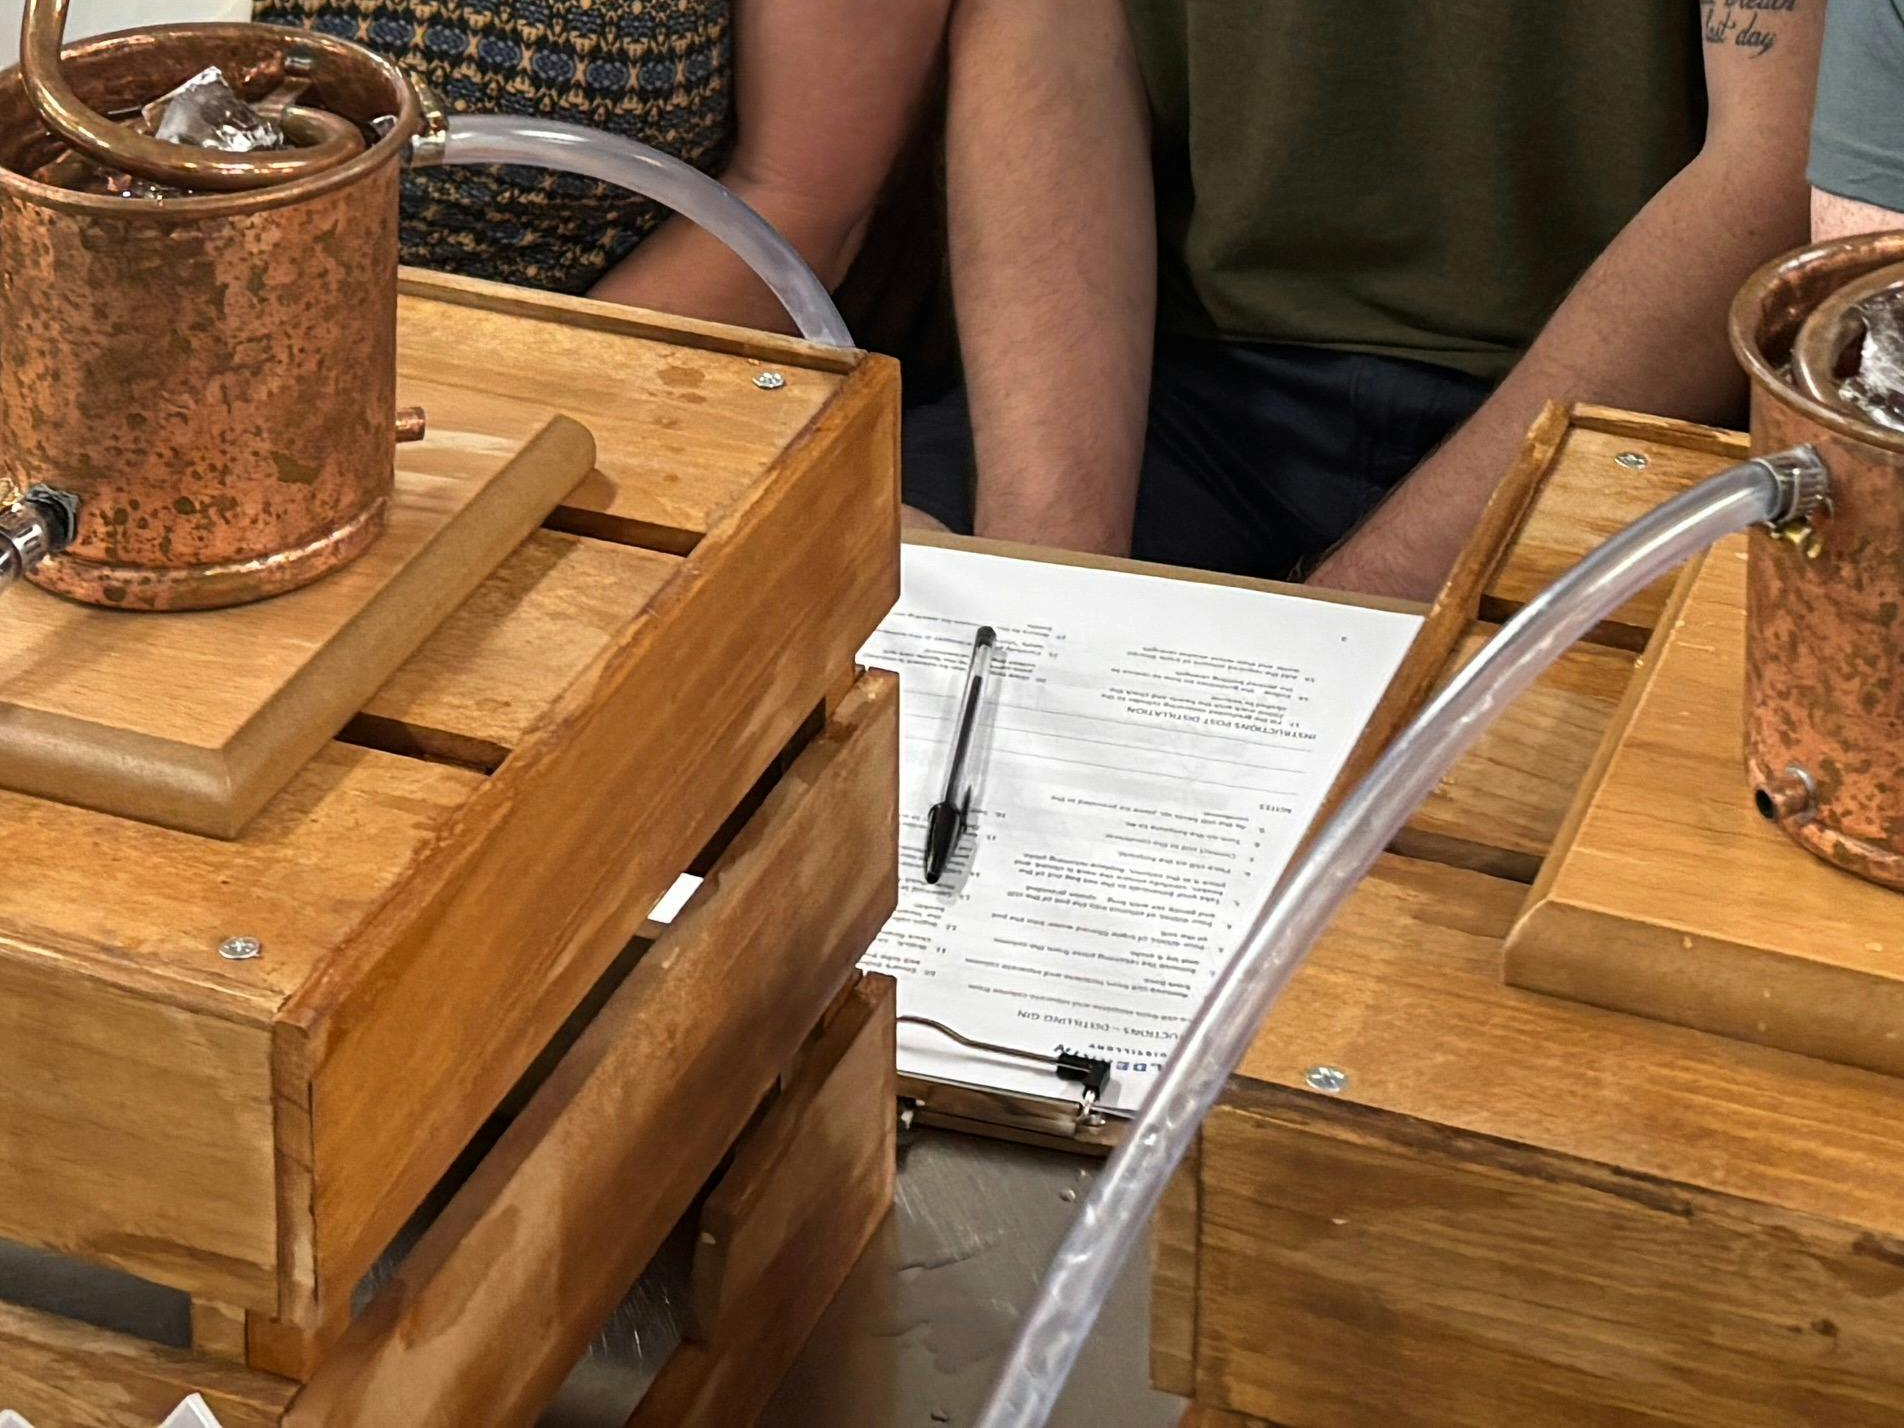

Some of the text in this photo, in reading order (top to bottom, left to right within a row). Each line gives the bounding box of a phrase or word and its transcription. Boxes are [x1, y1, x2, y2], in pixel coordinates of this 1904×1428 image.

[1735, 11, 1777, 60] day
[1127, 706, 1316, 739] INSTRUCTIONS POST DISTILLATION
[1017, 1010, 1040, 1020] GIN
